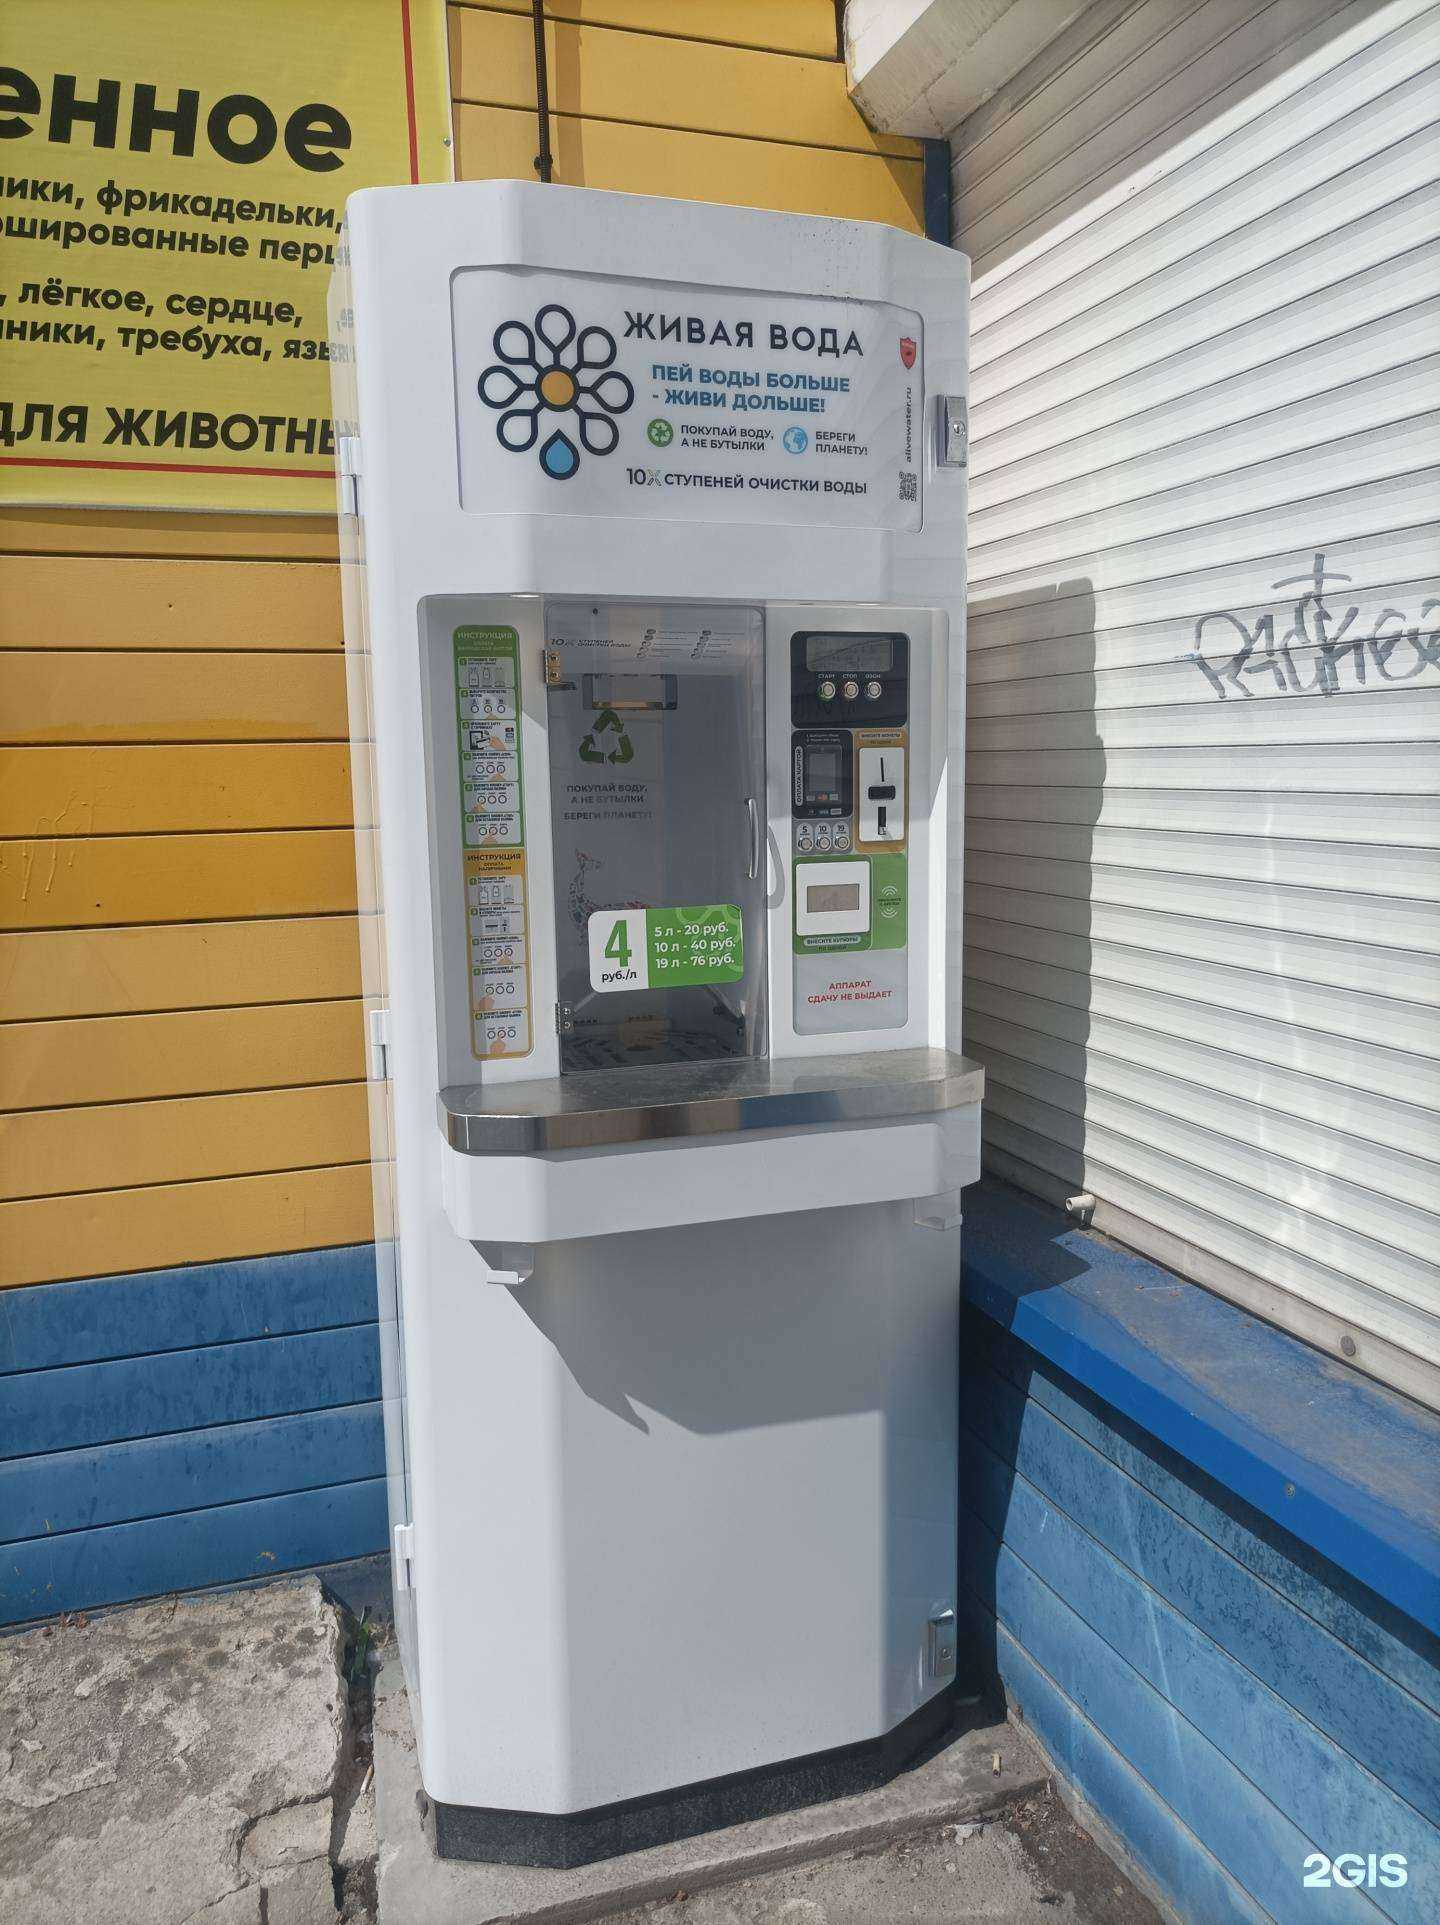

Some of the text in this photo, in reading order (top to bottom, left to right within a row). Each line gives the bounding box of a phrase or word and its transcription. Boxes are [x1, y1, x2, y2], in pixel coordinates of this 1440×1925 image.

[0, 176, 343, 234] ики, фрикадельки,
[0, 215, 249, 257] шированные
[18, 277, 154, 317] лёгкое,
[166, 292, 303, 328] сердце,
[0, 318, 105, 351] ники,
[117, 325, 271, 361] требуха,
[624, 311, 864, 357] ЖИВАЯ ВОДА
[652, 363, 850, 392] ПЕЙ ВОДЫ БОЛЬШЕ
[664, 389, 727, 408] ЖИВИ
[732, 392, 826, 413] ДОЛЬШЕ!
[680, 424, 774, 440] ПОКУПАЙ ВОДУ,
[815, 431, 856, 442] БЕРЕГИ
[680, 438, 765, 451] А НЕ БУТЫЛКИ
[815, 444, 868, 455] ПЛАНЕТУ!
[664, 473, 744, 489] СТУПЕНЕЙ
[748, 477, 820, 491] ОЧИСТКИ
[823, 481, 867, 495] ВОДЫ
[654, 927, 662, 937] 5
[684, 924, 700, 935] 20
[703, 922, 728, 936] руб.
[604, 920, 632, 967] 4
[654, 942, 668, 953] 10
[670, 943, 680, 952] л
[691, 939, 706, 950] 40
[710, 936, 736, 951] руб.
[655, 958, 668, 969] 19
[670, 958, 680, 968] л
[690, 955, 706, 967] 76
[709, 953, 735, 967] руб.
[602, 969, 637, 982] руб./л
[829, 980, 872, 991] АППАРАТ
[807, 990, 893, 1005] СДАЧУ НЕ ВЫДАЕТ
